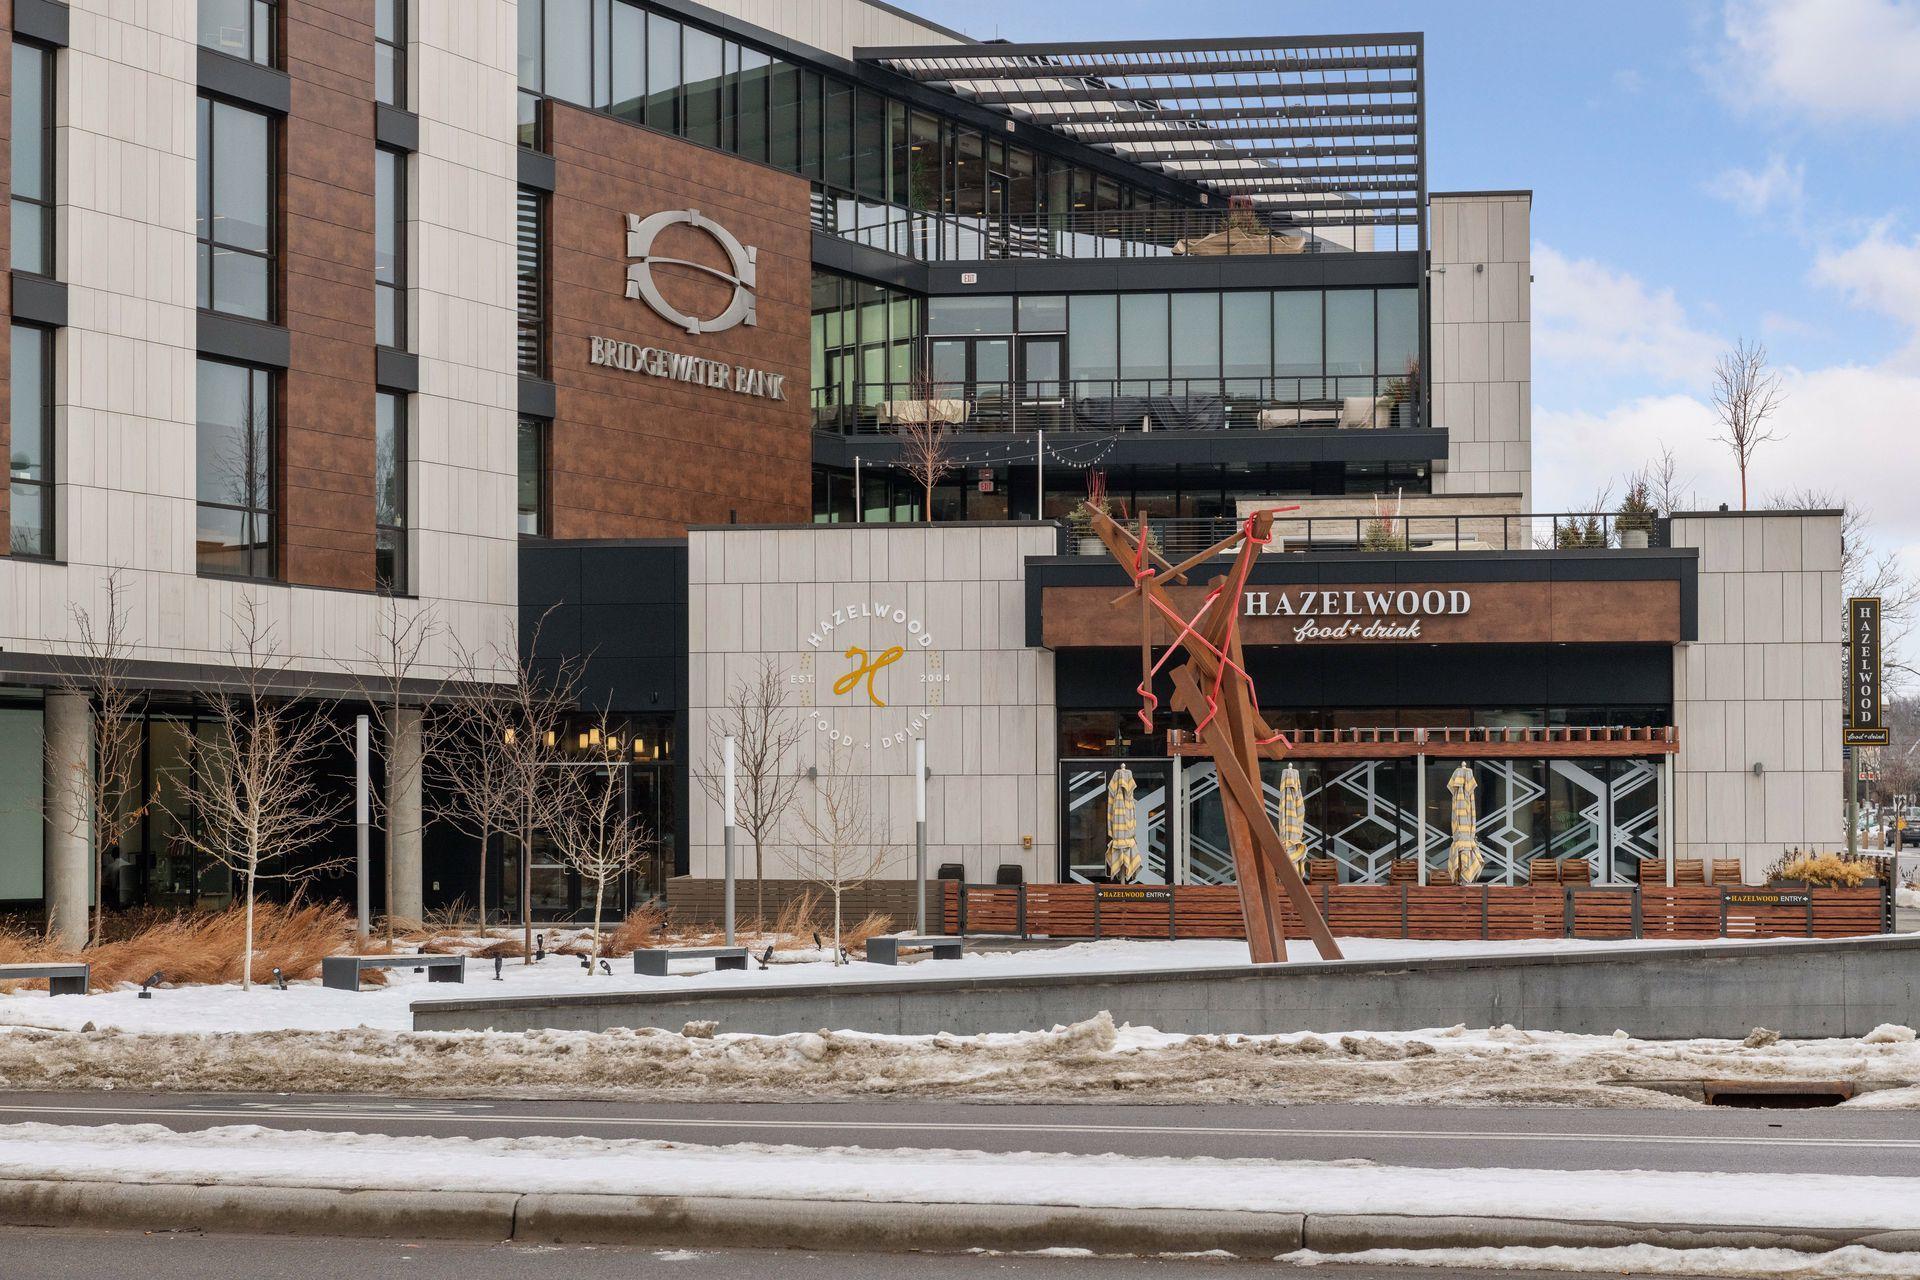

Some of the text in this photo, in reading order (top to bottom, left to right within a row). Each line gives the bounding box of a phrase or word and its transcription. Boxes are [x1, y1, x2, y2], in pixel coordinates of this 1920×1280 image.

[590, 336, 788, 401] BRIDGEWATER BANK
[981, 482, 992, 491] EXIT
[1244, 590, 1471, 616] HAZELWOOD
[807, 602, 932, 648] HAZELWOOD
[790, 674, 815, 684] EST.
[920, 674, 950, 683] 2004
[1859, 607, 1872, 722] HAZELWOOD
[809, 710, 853, 747] FOOD
[881, 709, 932, 749] DRINK
